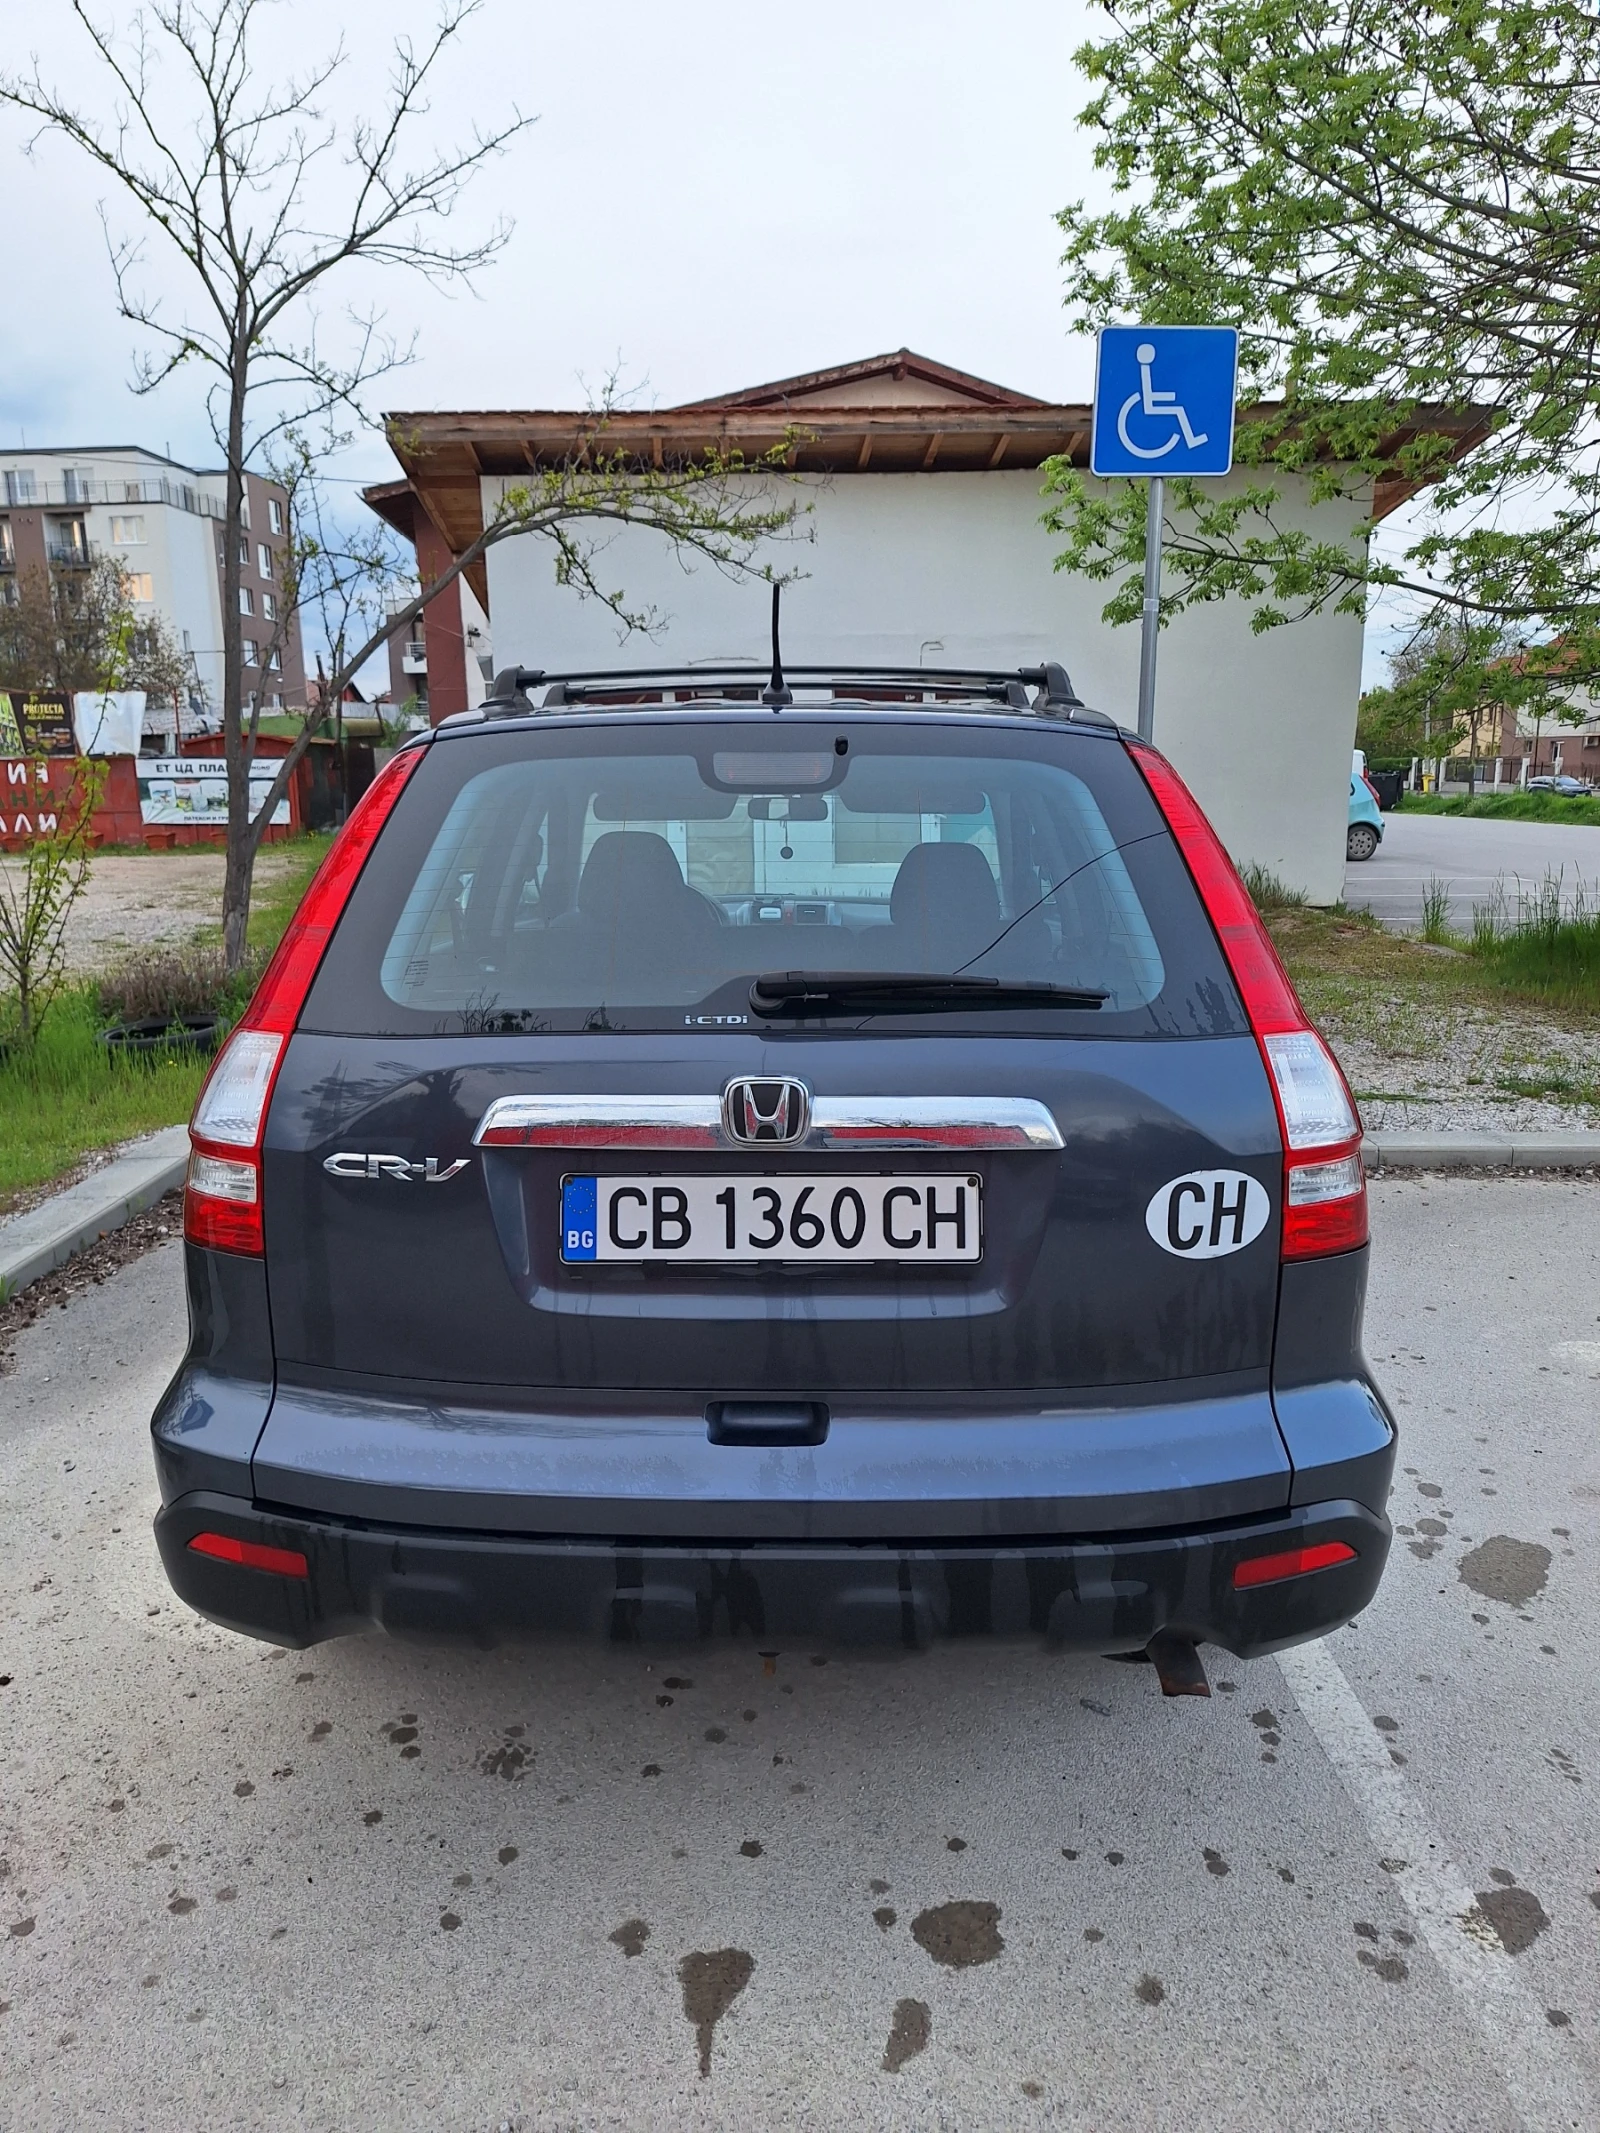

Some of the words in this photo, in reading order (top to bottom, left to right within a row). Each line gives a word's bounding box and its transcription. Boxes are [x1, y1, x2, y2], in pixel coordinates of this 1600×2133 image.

[23, 703, 65, 715] PROTECTA
[156, 764, 170, 773] ЕТ
[175, 764, 194, 774] ЦД
[199, 764, 227, 773] ПЛА
[685, 1015, 748, 1025] i-CTDi
[323, 1152, 472, 1182] CR-V
[609, 1186, 692, 1249] CB
[716, 1186, 866, 1249] 1360
[883, 1186, 966, 1249] CH
[1168, 1180, 1248, 1251] CH
[567, 1230, 594, 1249] BG
